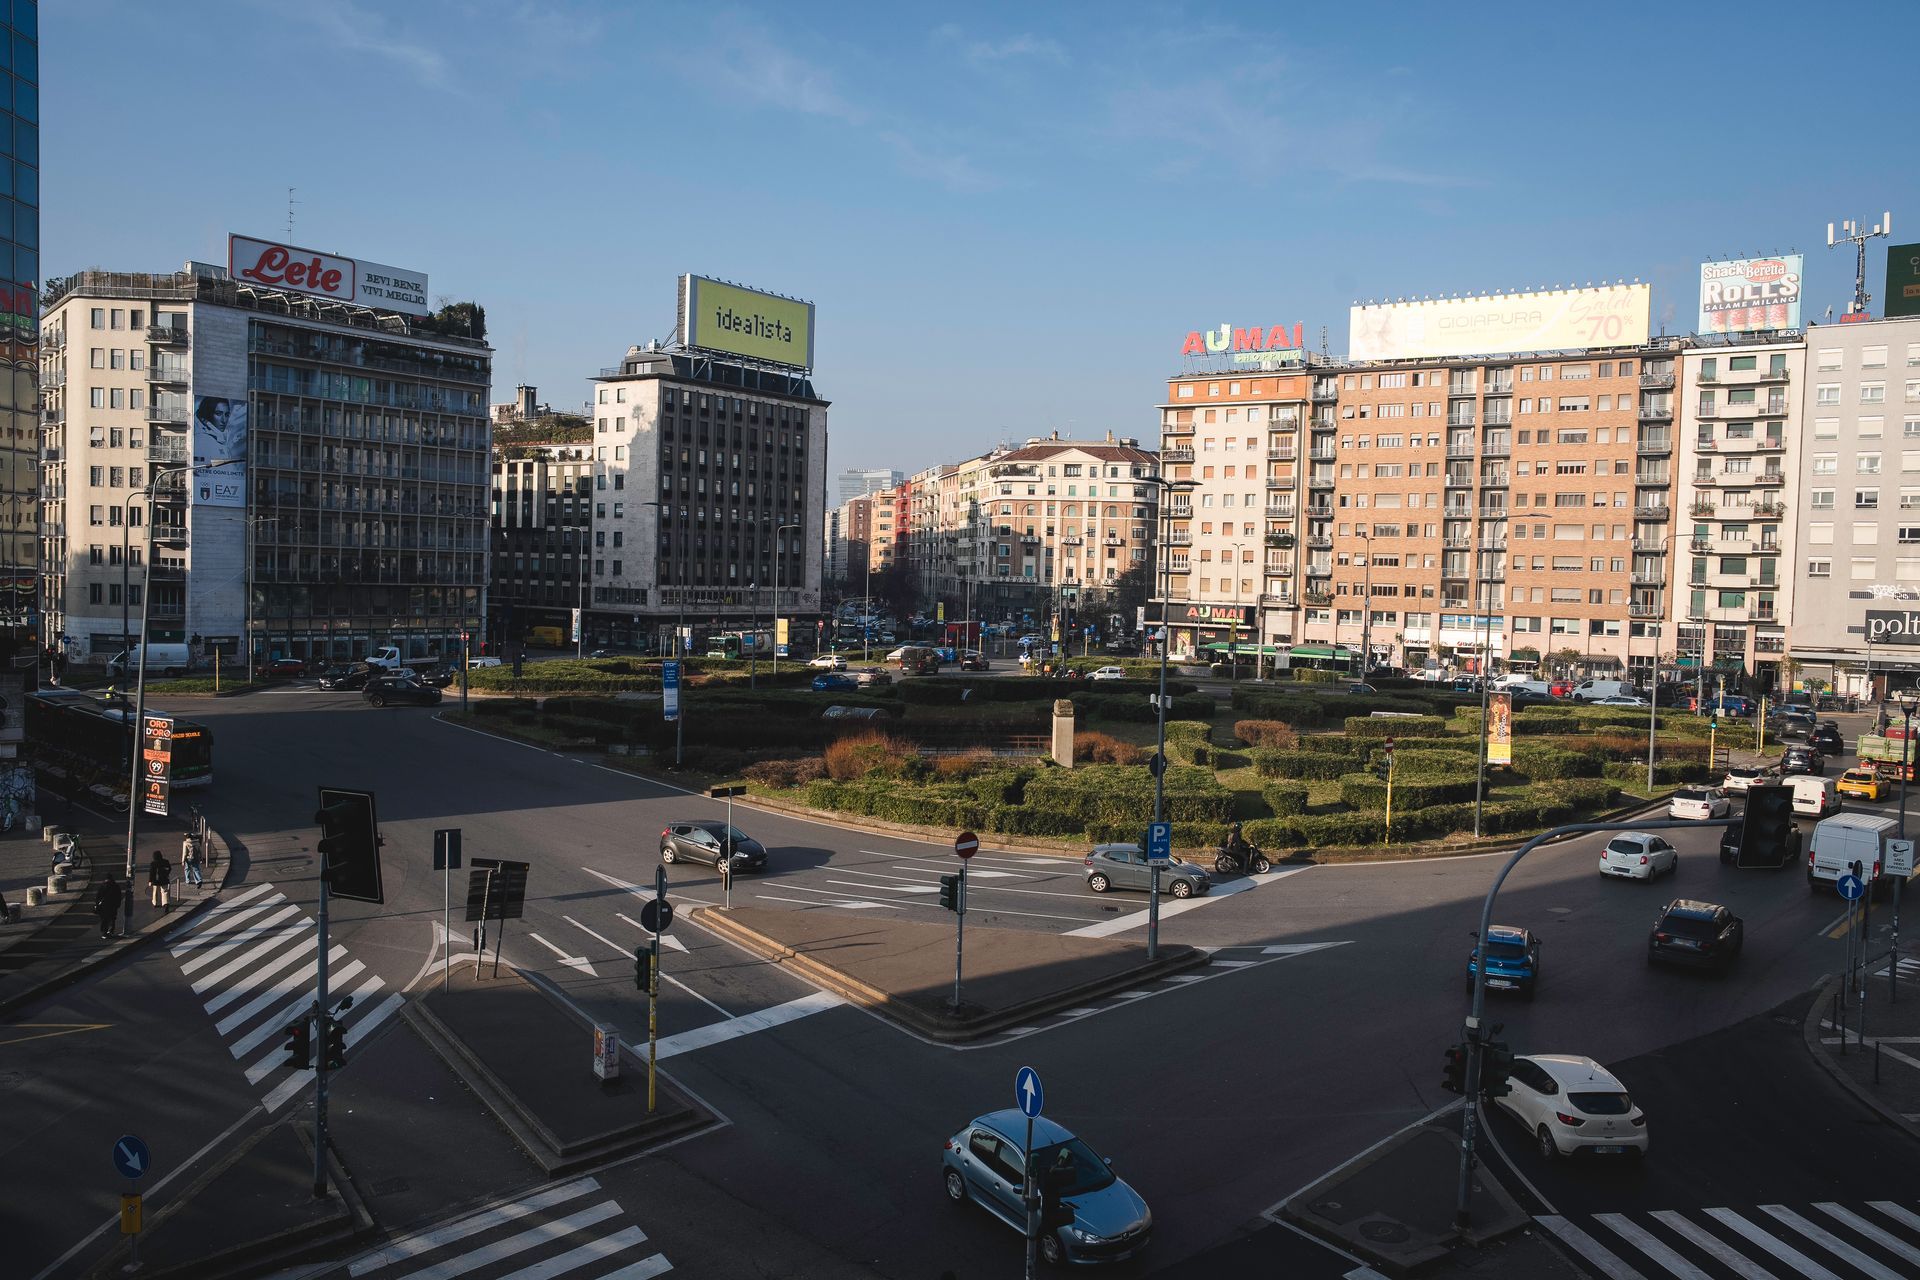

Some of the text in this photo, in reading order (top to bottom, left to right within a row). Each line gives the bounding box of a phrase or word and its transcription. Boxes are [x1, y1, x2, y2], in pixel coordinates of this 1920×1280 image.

[242, 246, 342, 292] Lete
[1704, 263, 1785, 280] Snack Beretta
[365, 273, 424, 294] BEVI BENE,
[360, 284, 427, 305] VIVI MEGLIO.
[1705, 296, 1795, 311] SALAME MILANO
[716, 306, 792, 343] idealista
[1438, 310, 1542, 329] GIOIAPURA
[1180, 322, 1303, 355] AUMAI
[1237, 352, 1300, 362] SHOPPING
[215, 484, 240, 496] EA7
[1186, 605, 1245, 619] AUMAI
[149, 719, 168, 729] ORO
[151, 761, 162, 772] 99
[1153, 825, 1166, 843] P
